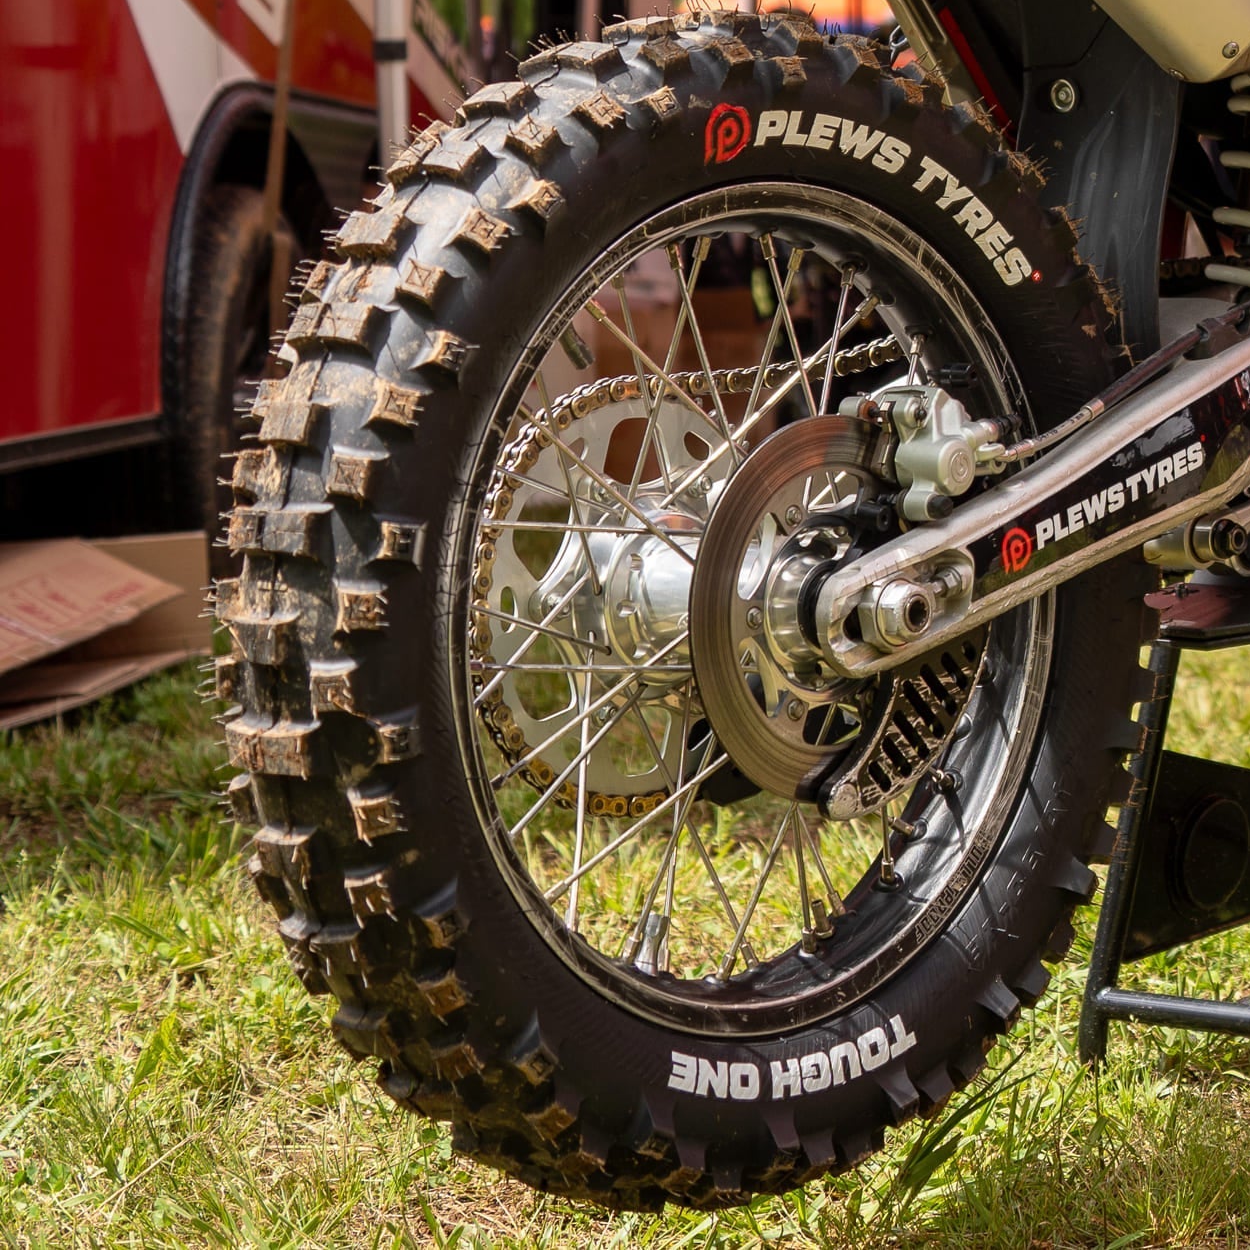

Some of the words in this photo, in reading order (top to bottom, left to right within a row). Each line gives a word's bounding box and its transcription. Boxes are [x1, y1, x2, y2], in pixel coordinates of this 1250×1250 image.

[753, 110, 911, 174] PLEWS
[911, 155, 1033, 287] TYRES
[1035, 481, 1126, 551] PLEWS
[1125, 441, 1205, 503] TYRES
[667, 1049, 761, 1100] ONE
[769, 1013, 918, 1100] TOUGH
